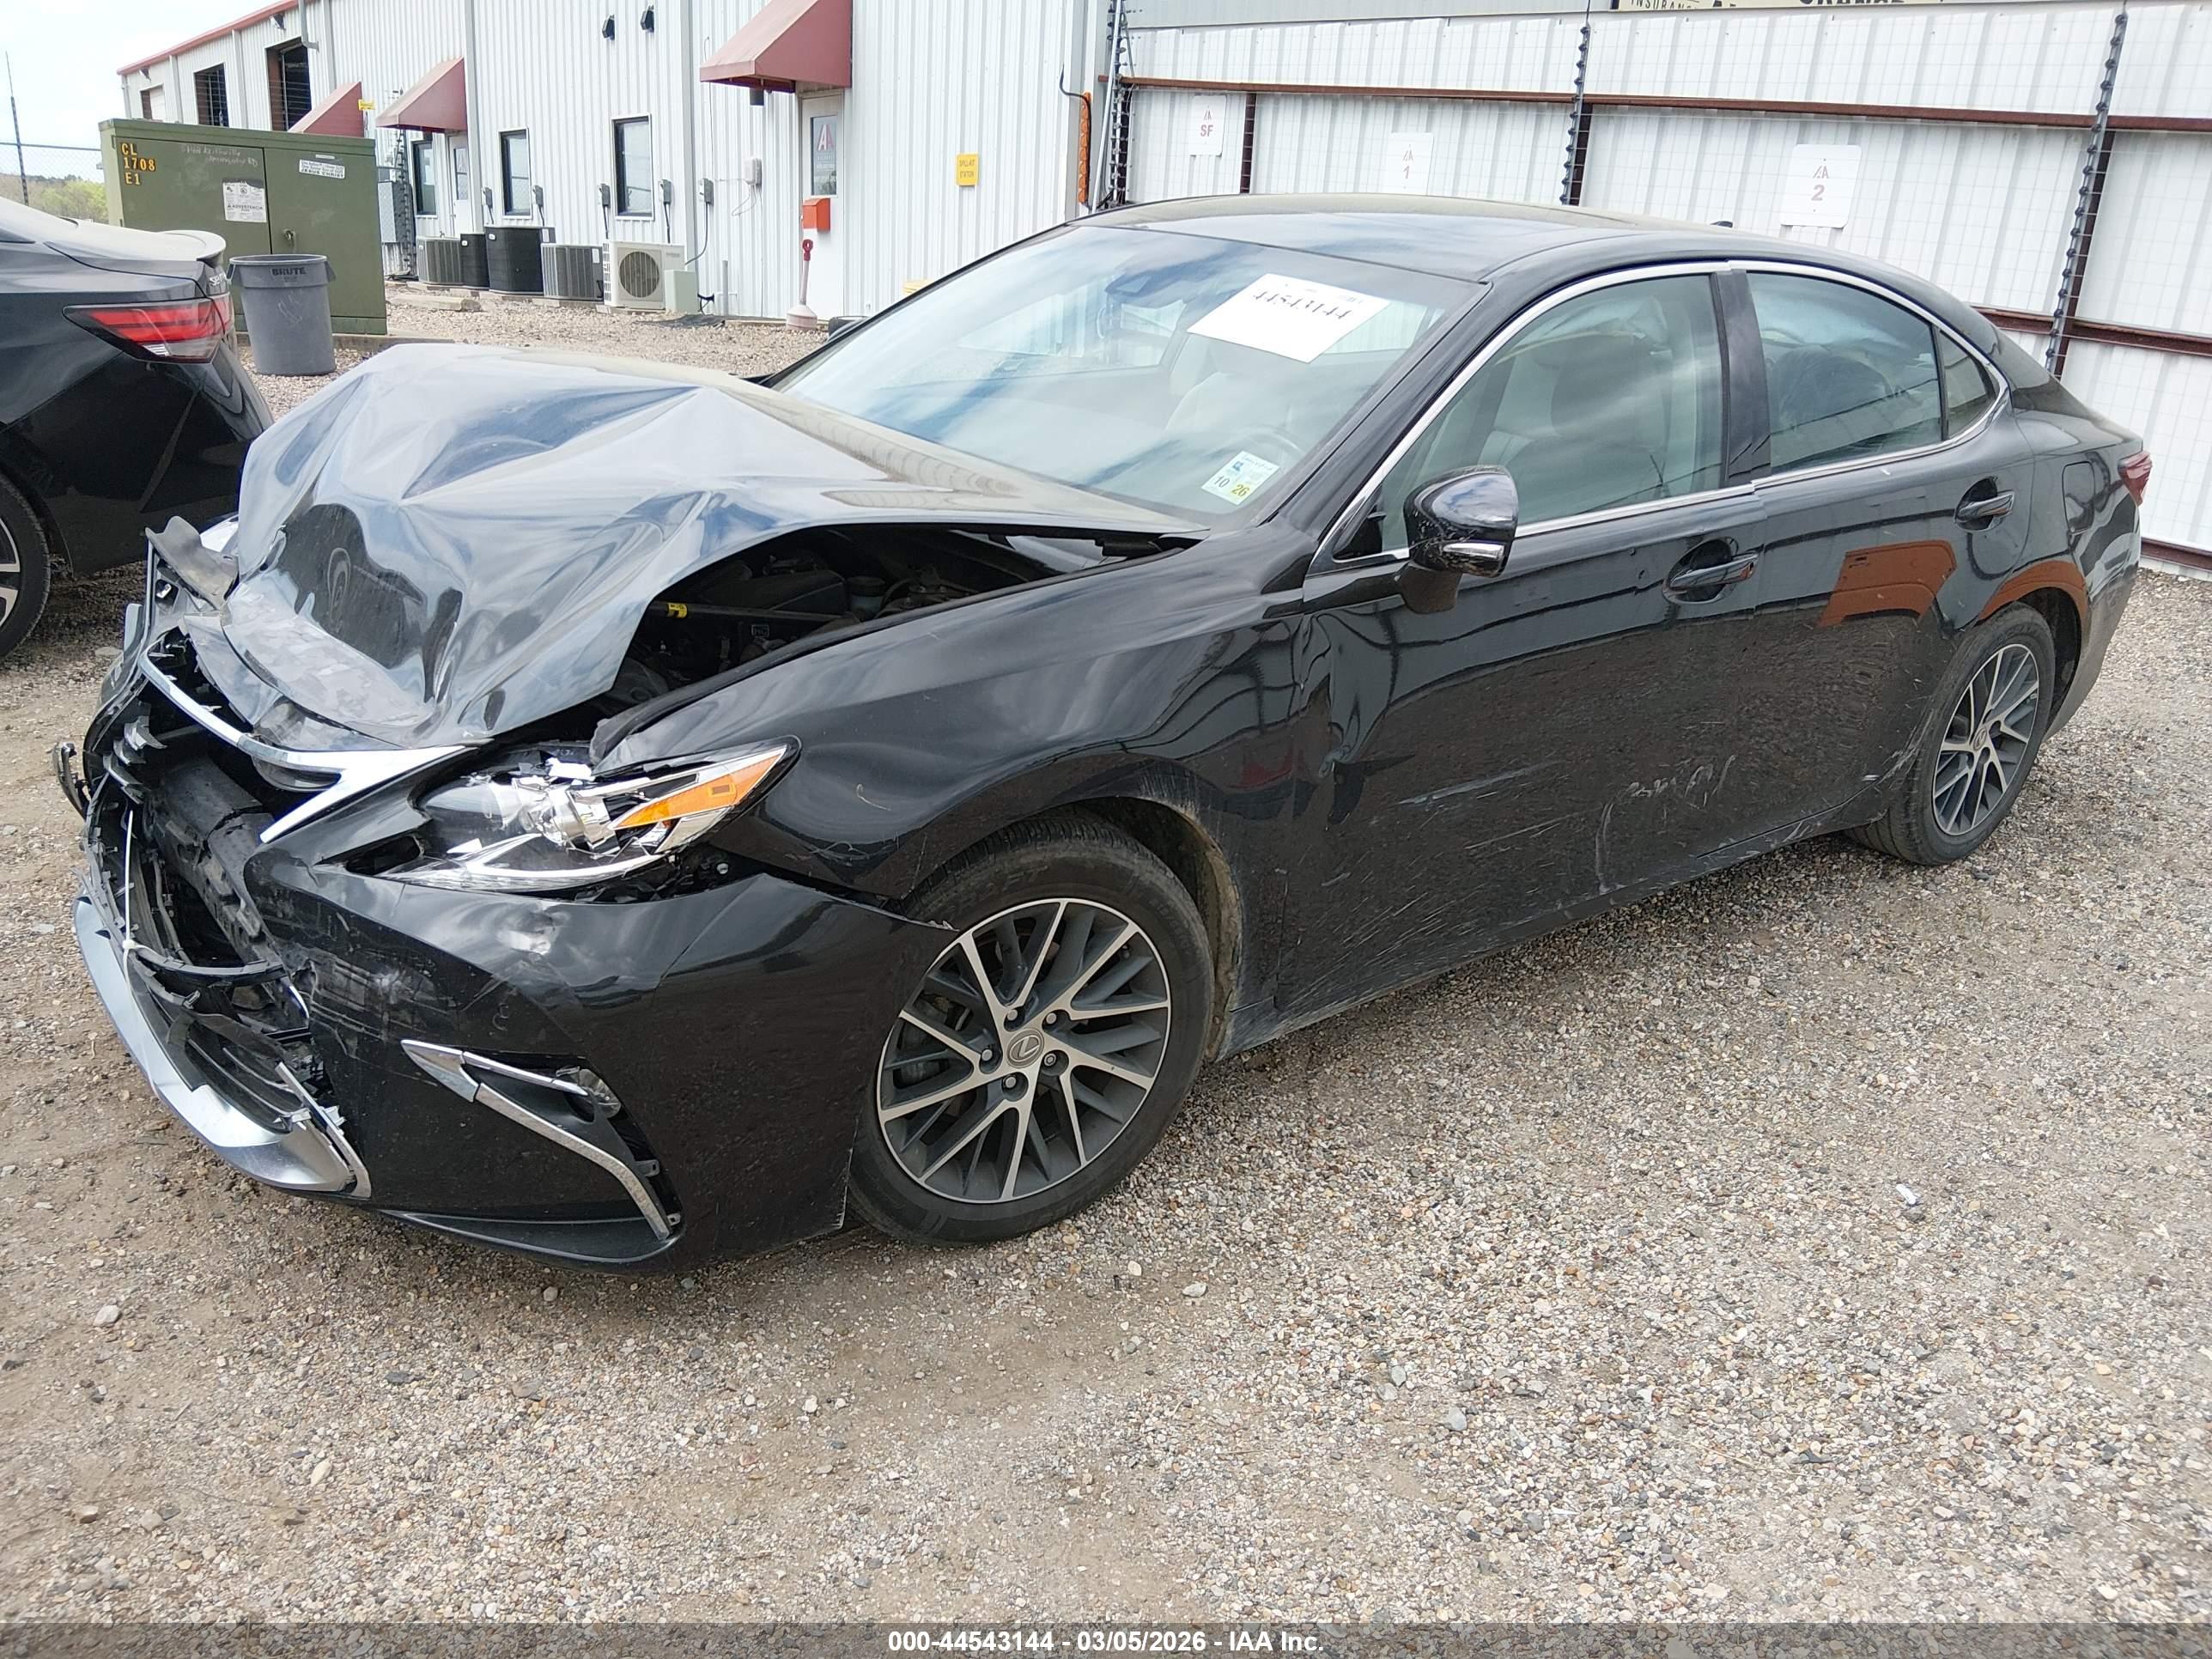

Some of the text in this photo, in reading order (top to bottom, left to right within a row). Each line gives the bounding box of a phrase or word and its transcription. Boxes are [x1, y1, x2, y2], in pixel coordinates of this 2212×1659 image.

[1200, 124, 1214, 137] SF
[121, 143, 137, 155] CL
[124, 156, 155, 171] 1708
[125, 172, 140, 185] E1
[1403, 165, 1410, 179] 1
[1810, 184, 1826, 201] 2
[271, 267, 307, 276] BRUTE
[1213, 475, 1231, 489] 10
[1231, 483, 1250, 497] 26
